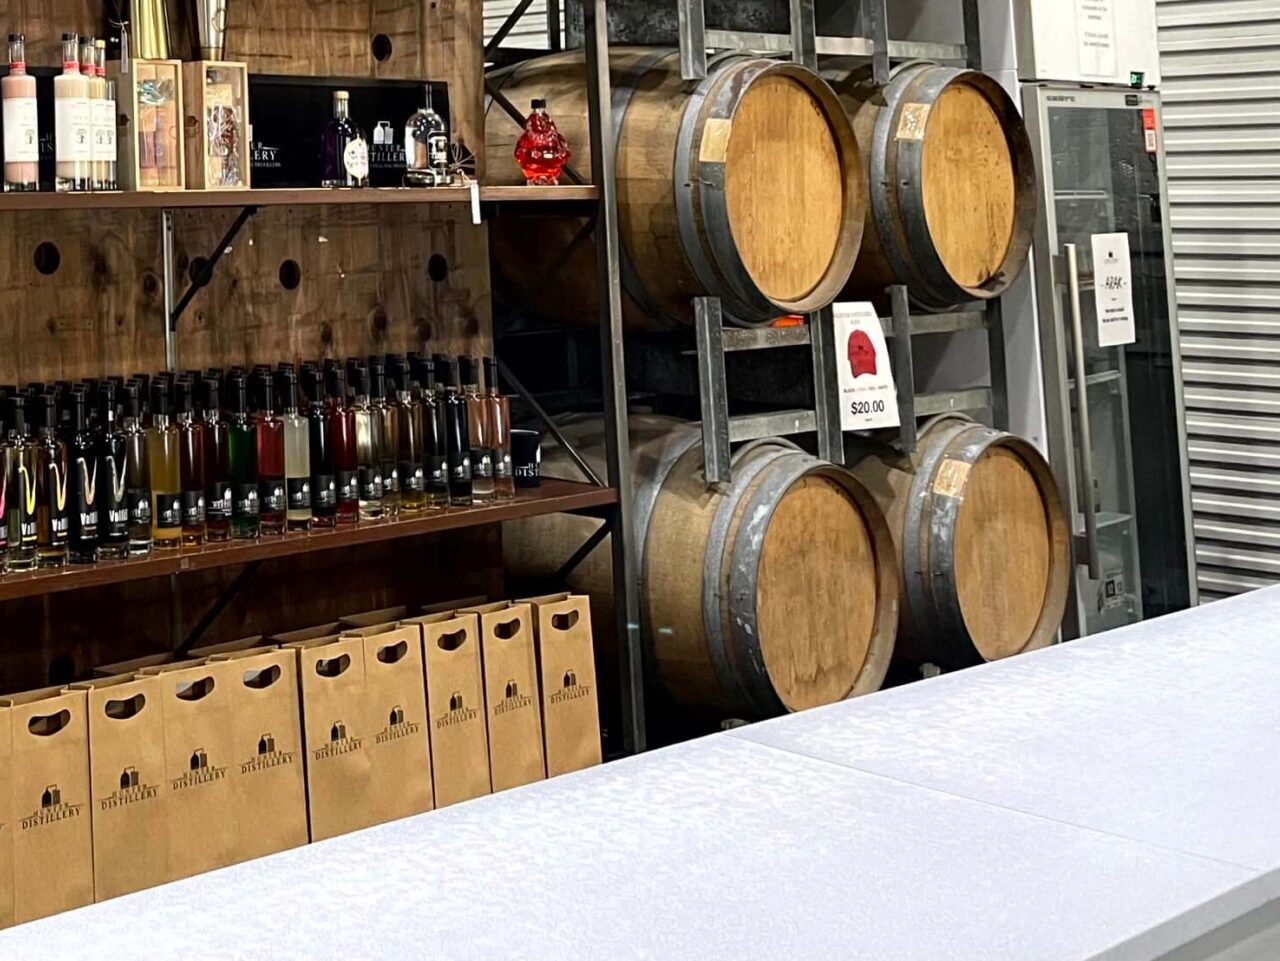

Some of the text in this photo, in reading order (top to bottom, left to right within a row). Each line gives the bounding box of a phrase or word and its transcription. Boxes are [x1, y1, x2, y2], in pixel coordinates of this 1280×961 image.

[851, 400, 884, 415] $20.00
[550, 688, 590, 705] DISTILLERY
[494, 698, 532, 715] DISTILLERY
[437, 711, 477, 729] DISTILLERY
[376, 726, 419, 744] DISTILLERY
[315, 741, 362, 760] DISTILLERY
[241, 755, 293, 774] DISTILLERY
[173, 769, 226, 791] DISTILLERY
[101, 788, 158, 811] DISTILLERY
[112, 784, 147, 798] HUNTER
[22, 807, 81, 830] DISTILLERY
[33, 802, 69, 817] HUNTER
